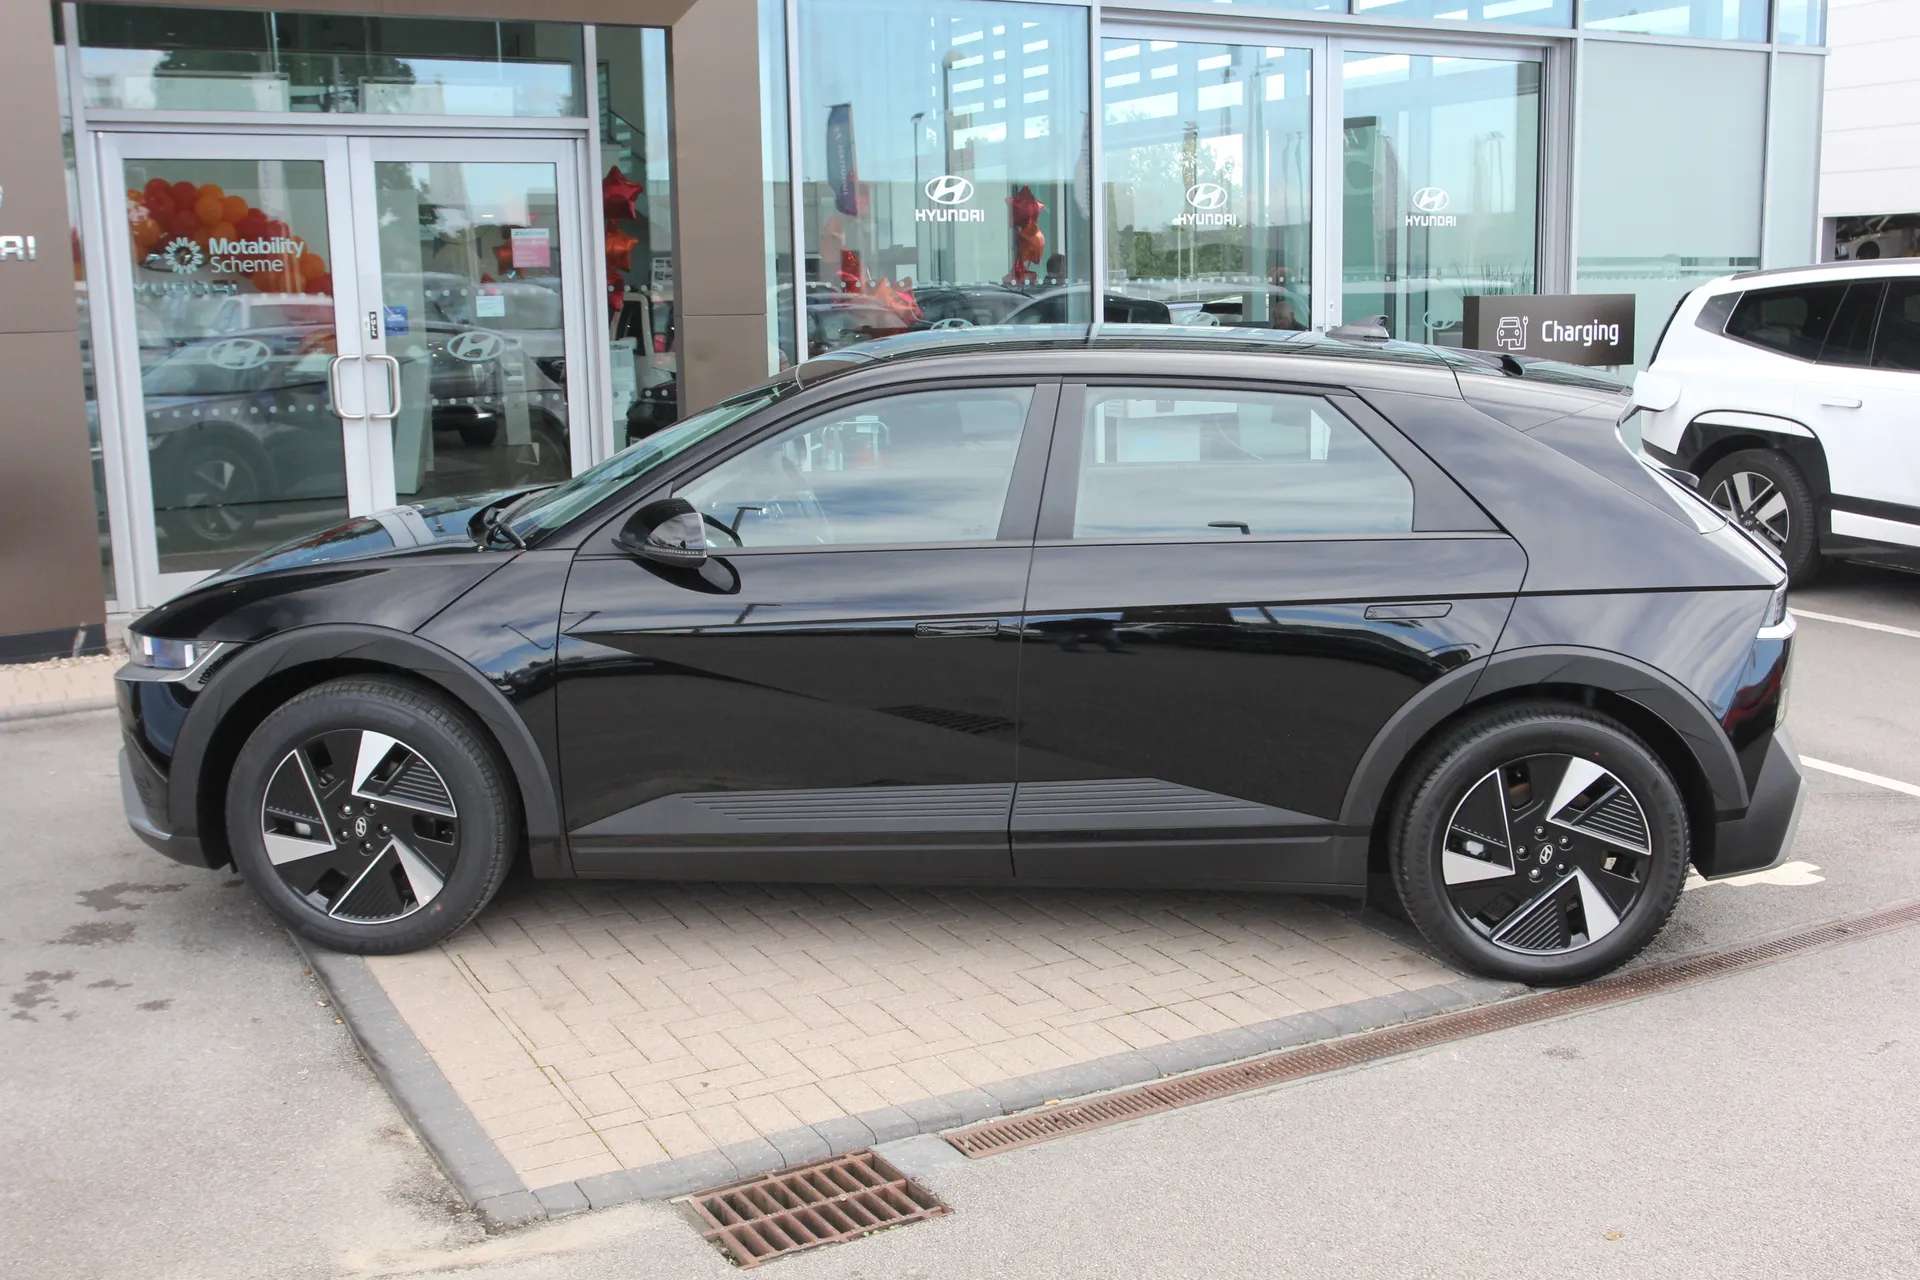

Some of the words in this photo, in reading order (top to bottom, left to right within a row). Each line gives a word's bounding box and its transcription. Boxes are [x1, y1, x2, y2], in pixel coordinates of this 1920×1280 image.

[915, 208, 985, 222] HYUNDAI
[1178, 213, 1237, 225] HYUNDAI
[1405, 215, 1457, 227] HYUNDAI
[208, 236, 305, 258] Motability
[210, 256, 284, 273] Scheme
[1541, 318, 1620, 347] Charging
